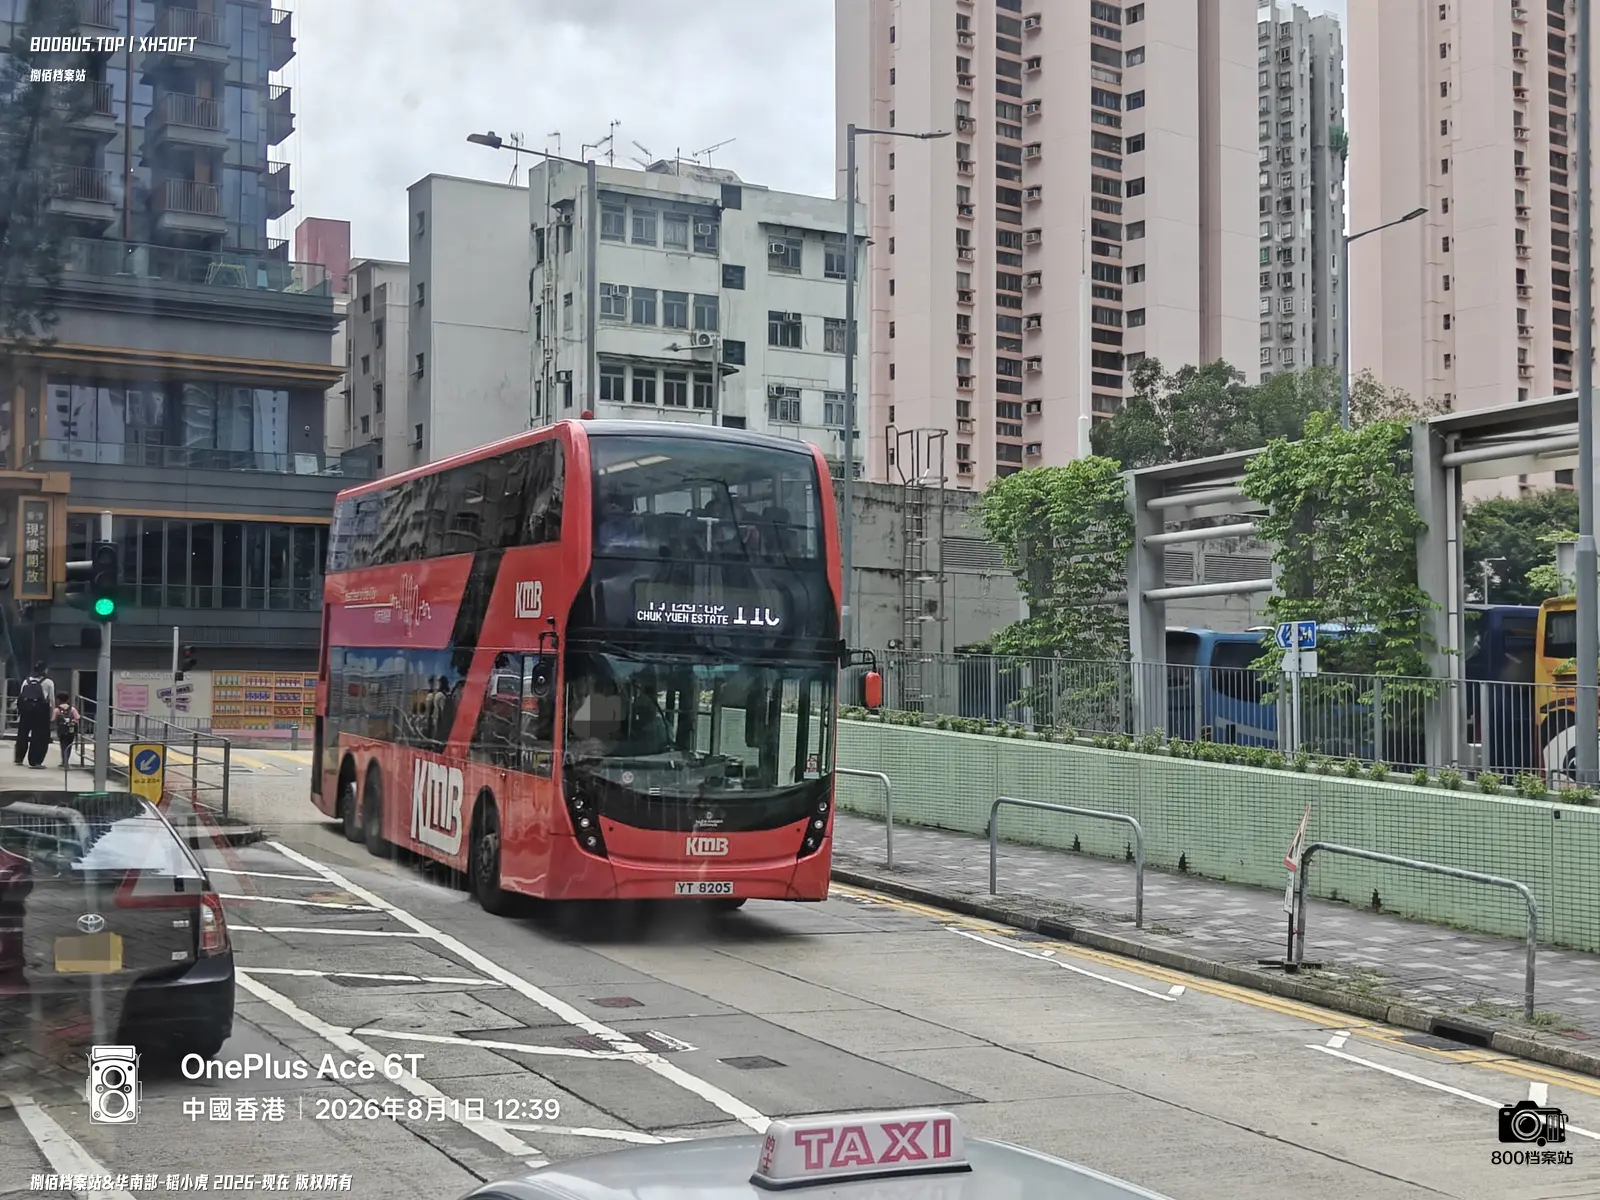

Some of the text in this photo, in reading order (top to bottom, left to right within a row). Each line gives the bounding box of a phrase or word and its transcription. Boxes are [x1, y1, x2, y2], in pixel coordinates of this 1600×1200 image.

[25, 522, 40, 583] 現樓開放
[636, 610, 729, 625] CHUK YUEN ESTATE
[678, 883, 731, 893] YT 8205
[795, 1118, 951, 1170] TAXI
